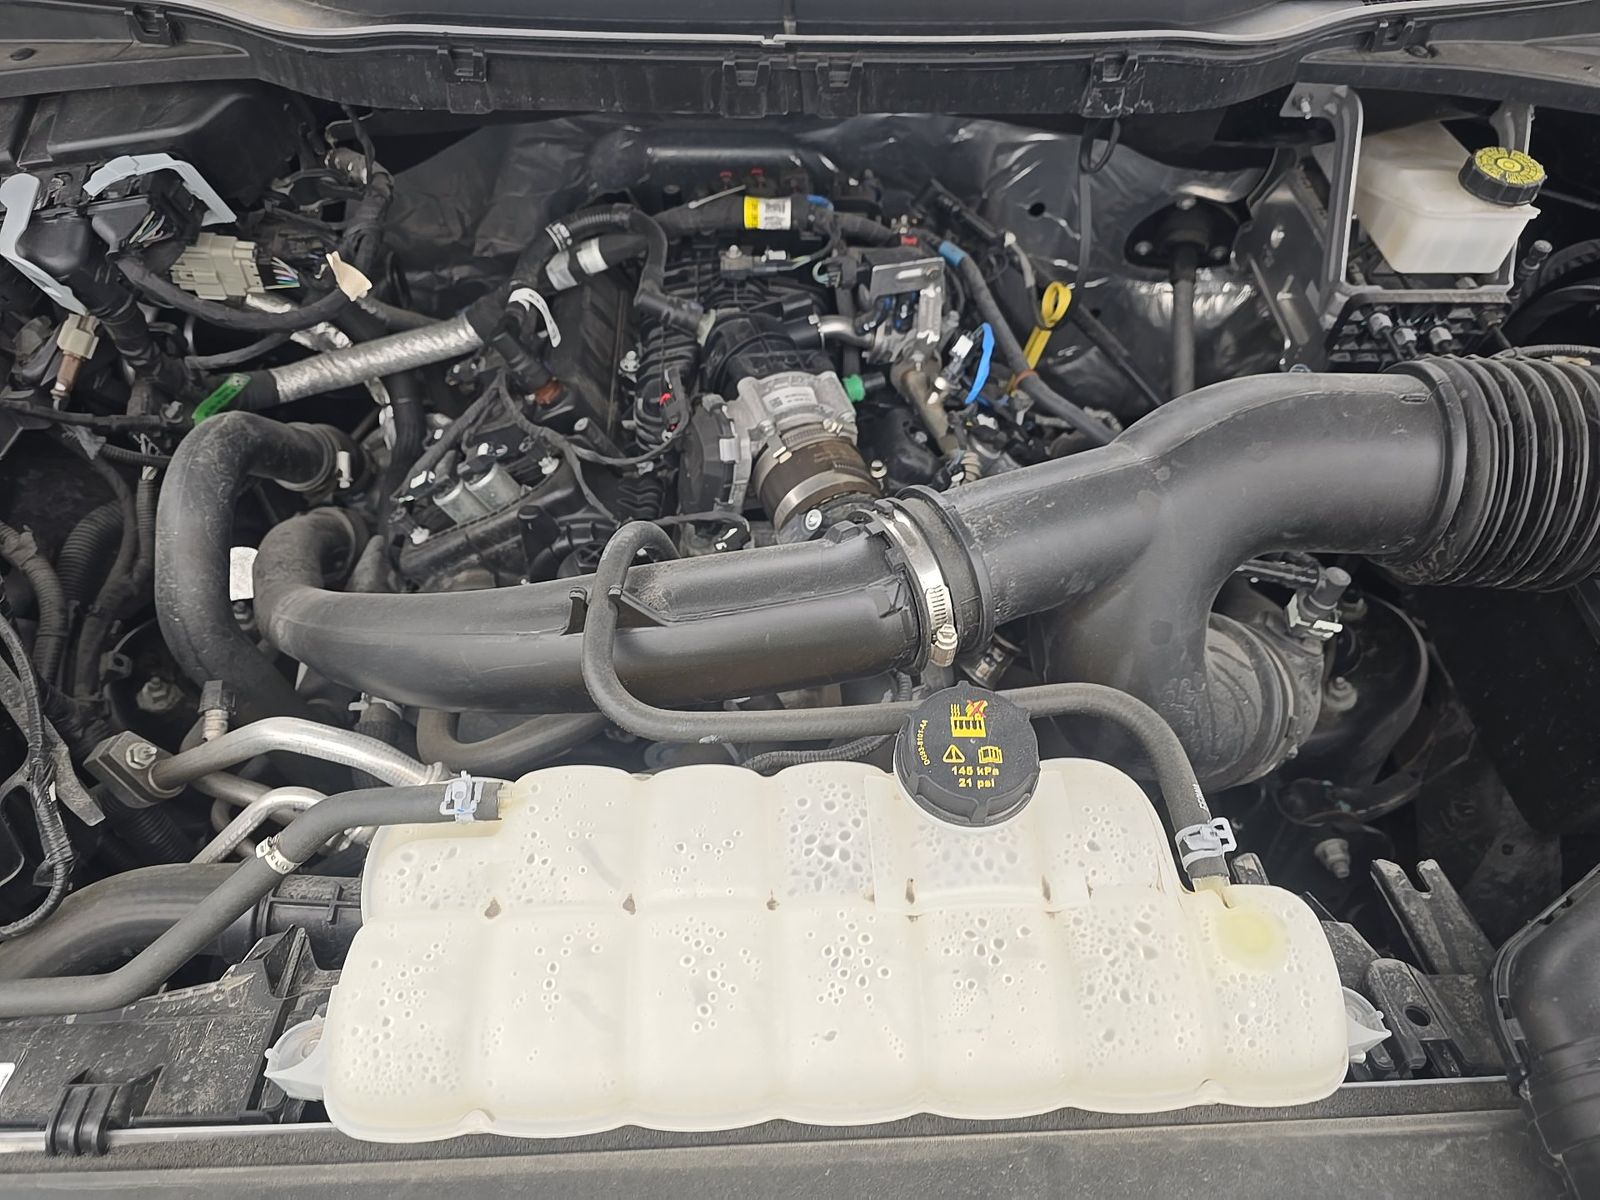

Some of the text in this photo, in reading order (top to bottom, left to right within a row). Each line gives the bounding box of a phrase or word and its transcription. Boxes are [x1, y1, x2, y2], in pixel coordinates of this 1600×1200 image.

[951, 765, 1000, 776] 145 kPa
[958, 778, 995, 790] 21 psi
